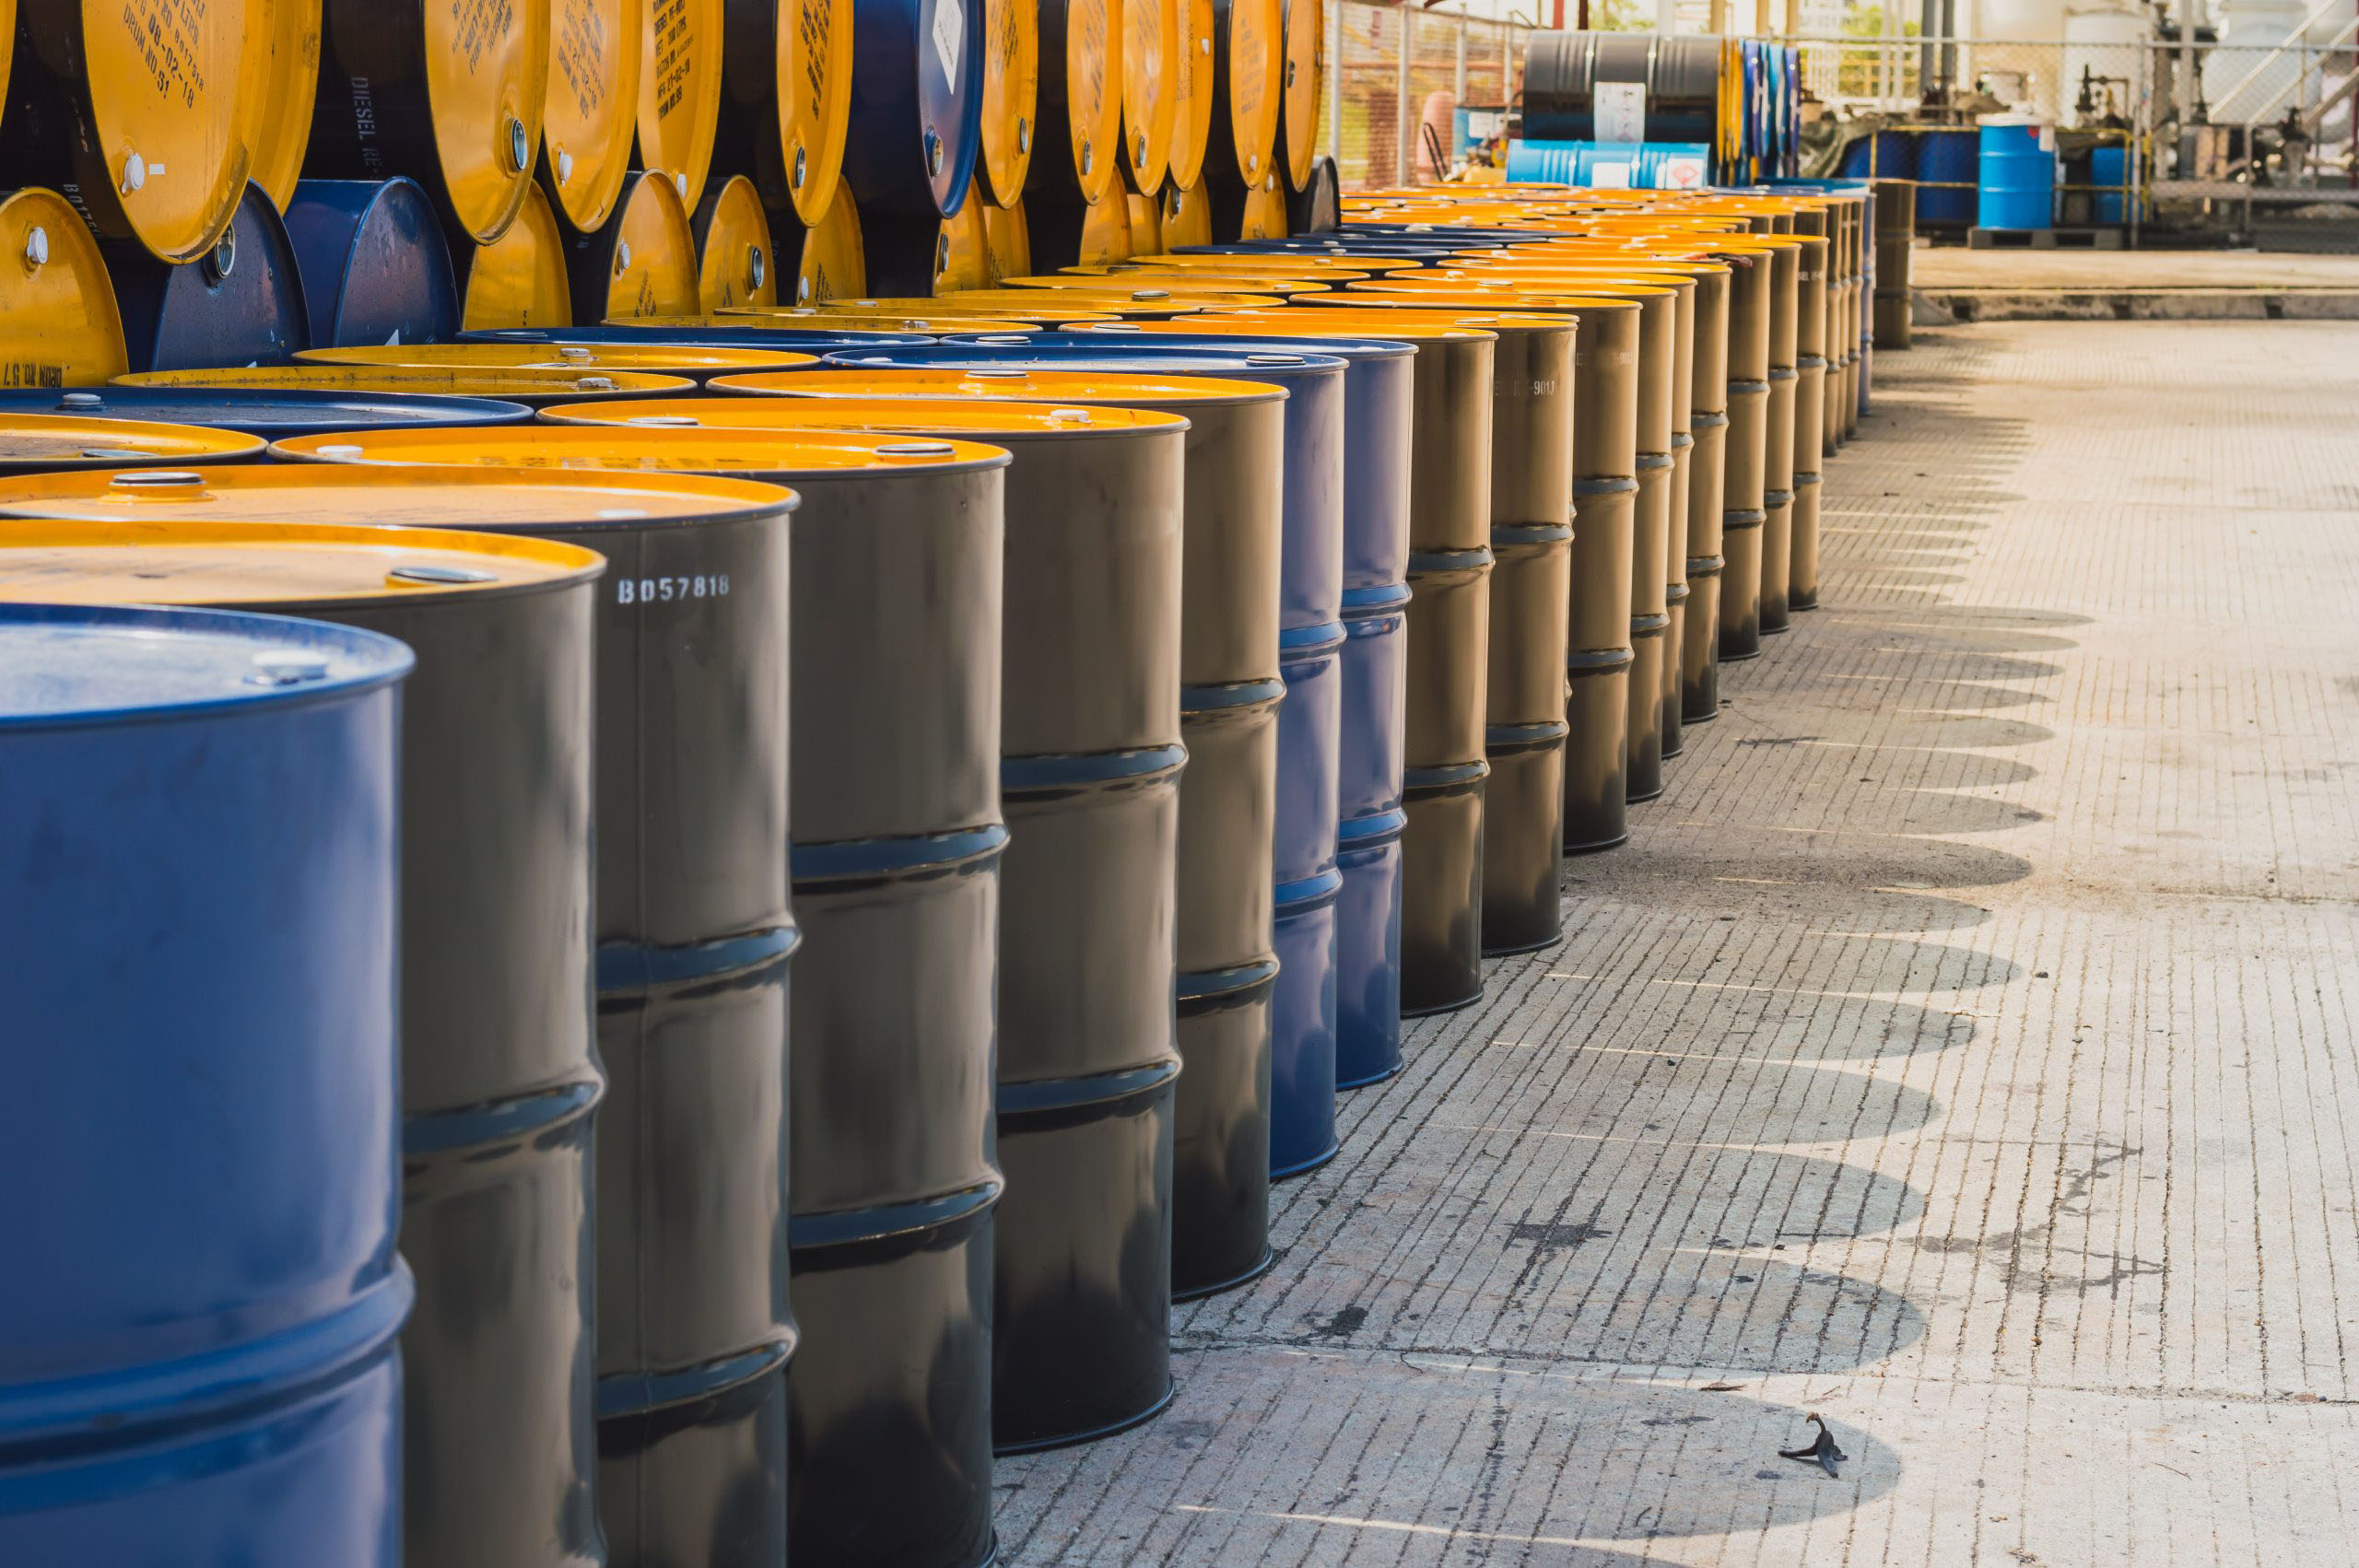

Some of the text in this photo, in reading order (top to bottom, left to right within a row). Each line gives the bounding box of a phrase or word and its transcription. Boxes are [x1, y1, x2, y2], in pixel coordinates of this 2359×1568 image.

[123, 3, 146, 53] DRUM
[149, 13, 194, 109] 08-02-18
[351, 77, 375, 140] DIESEL
[617, 575, 729, 604] B057818
